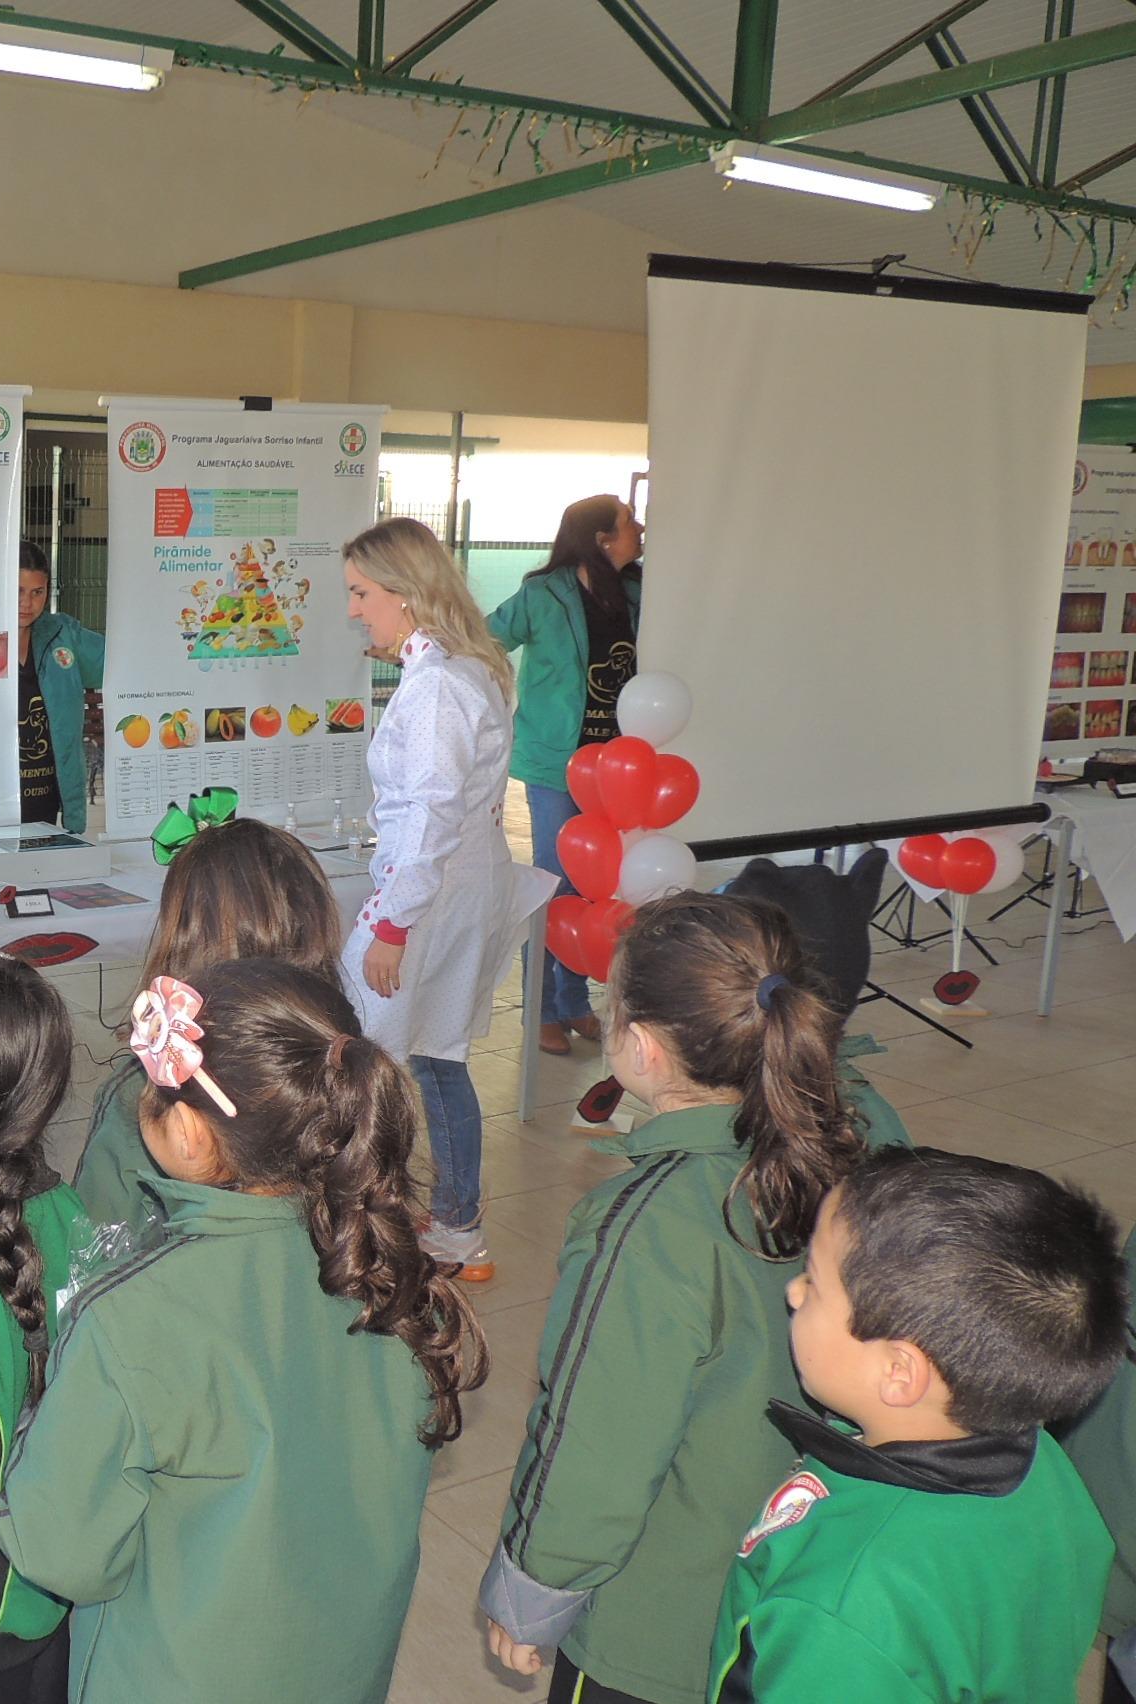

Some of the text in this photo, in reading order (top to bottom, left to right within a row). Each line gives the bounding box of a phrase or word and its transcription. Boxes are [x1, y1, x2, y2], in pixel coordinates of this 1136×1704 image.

[172, 434, 212, 445] Programa
[264, 435, 294, 445] Sorriso
[296, 436, 323, 445] Infantil
[197, 459, 295, 470] ALIMENTAÇÃO SAUDÁVEL
[154, 545, 211, 558] Pirâmide
[159, 560, 223, 572] Alimentar
[24, 785, 49, 797] OURO
